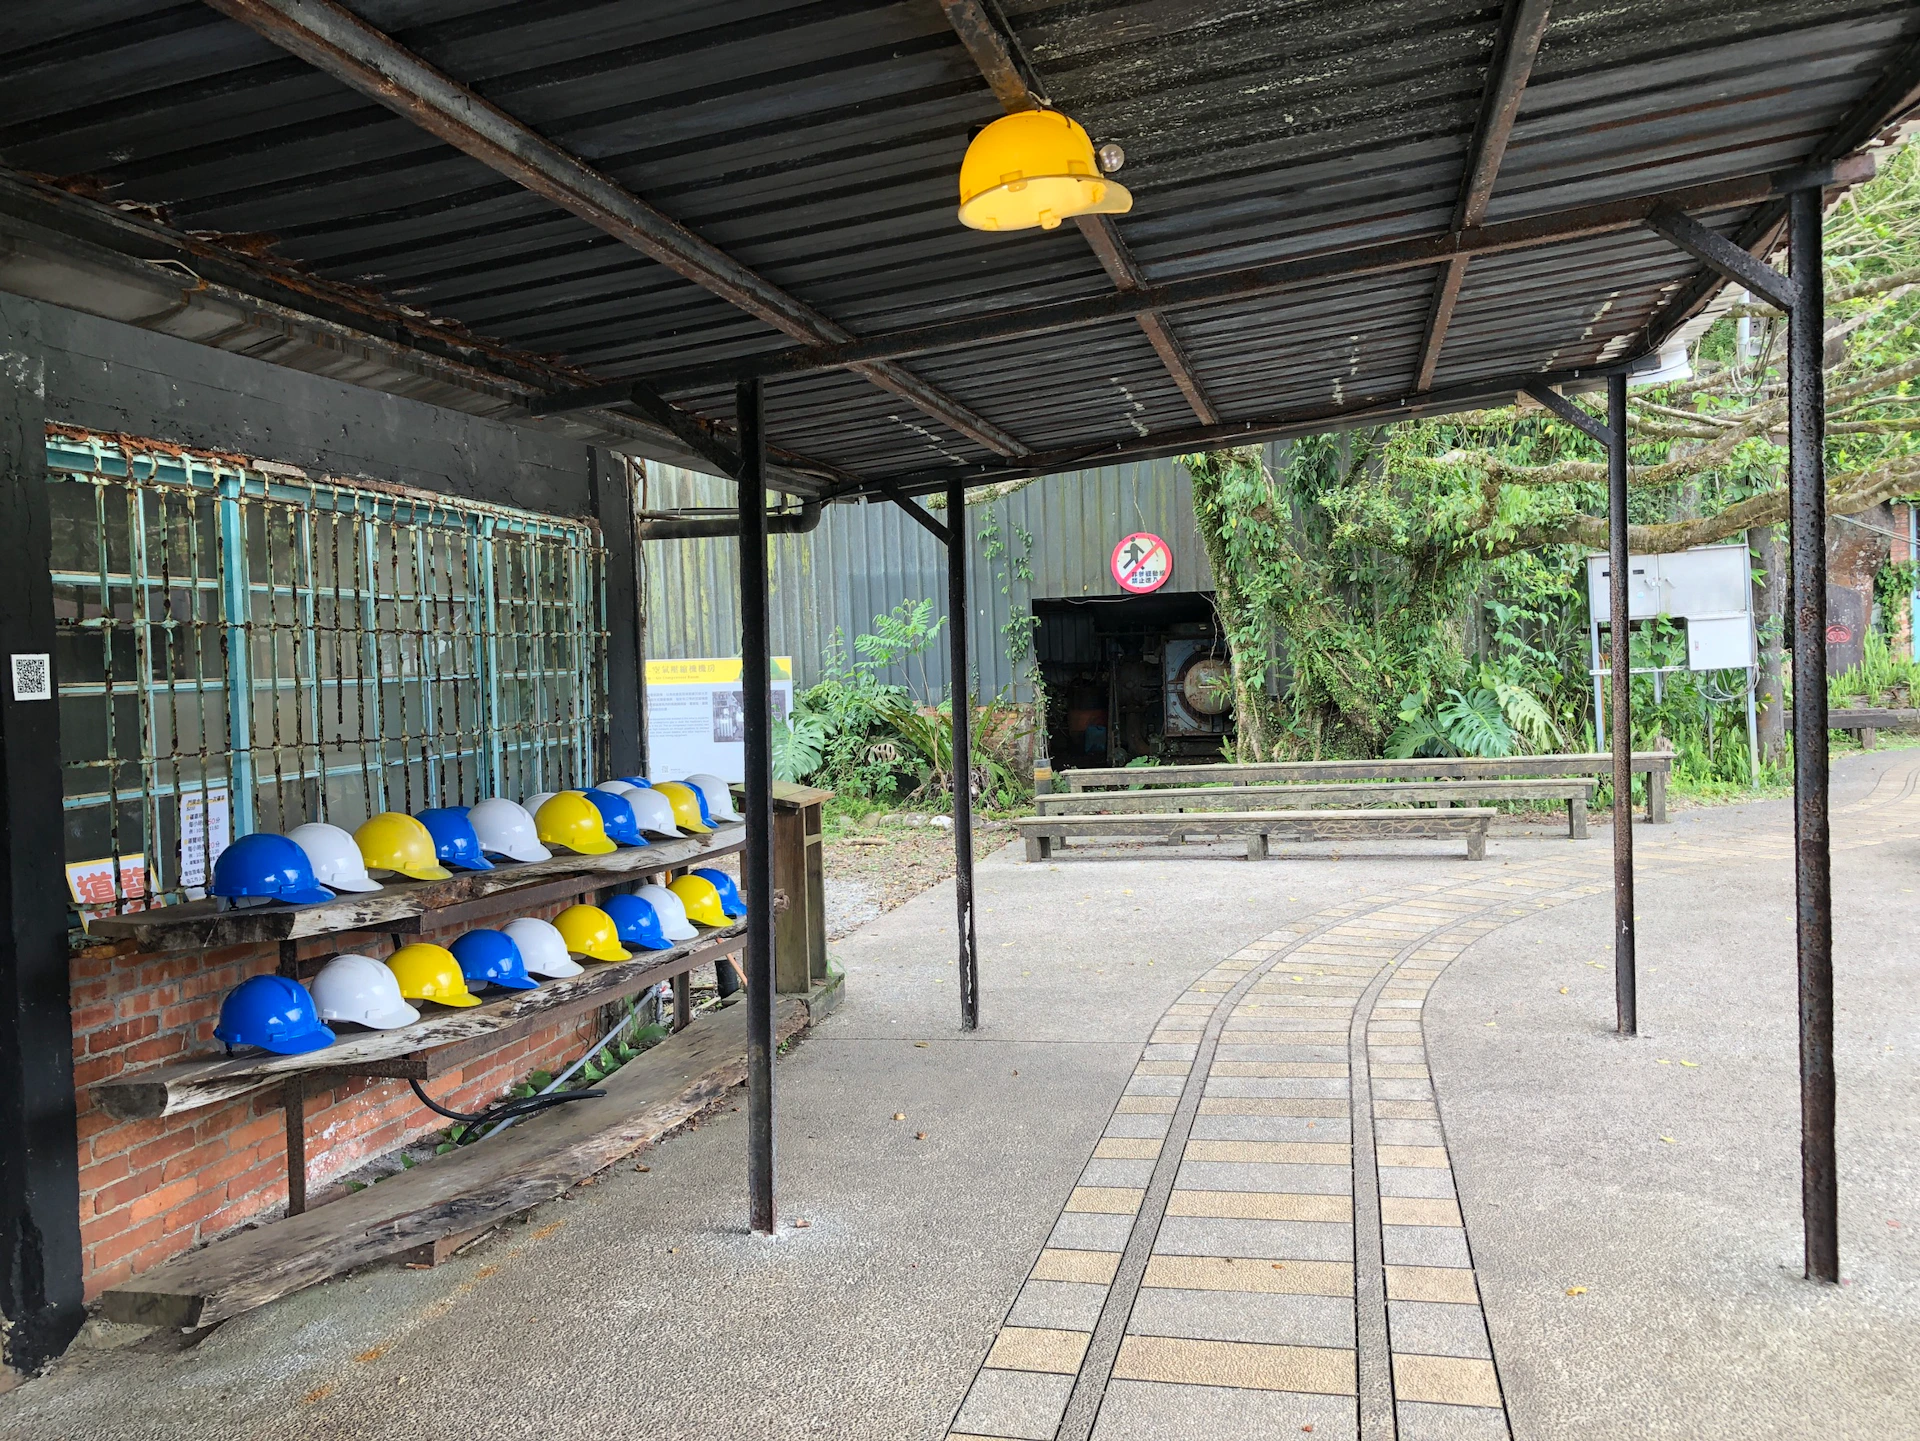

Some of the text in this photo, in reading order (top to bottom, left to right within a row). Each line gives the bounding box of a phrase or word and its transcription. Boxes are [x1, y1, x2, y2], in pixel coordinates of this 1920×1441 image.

[652, 664, 715, 674] 空氣壓縮機機房
